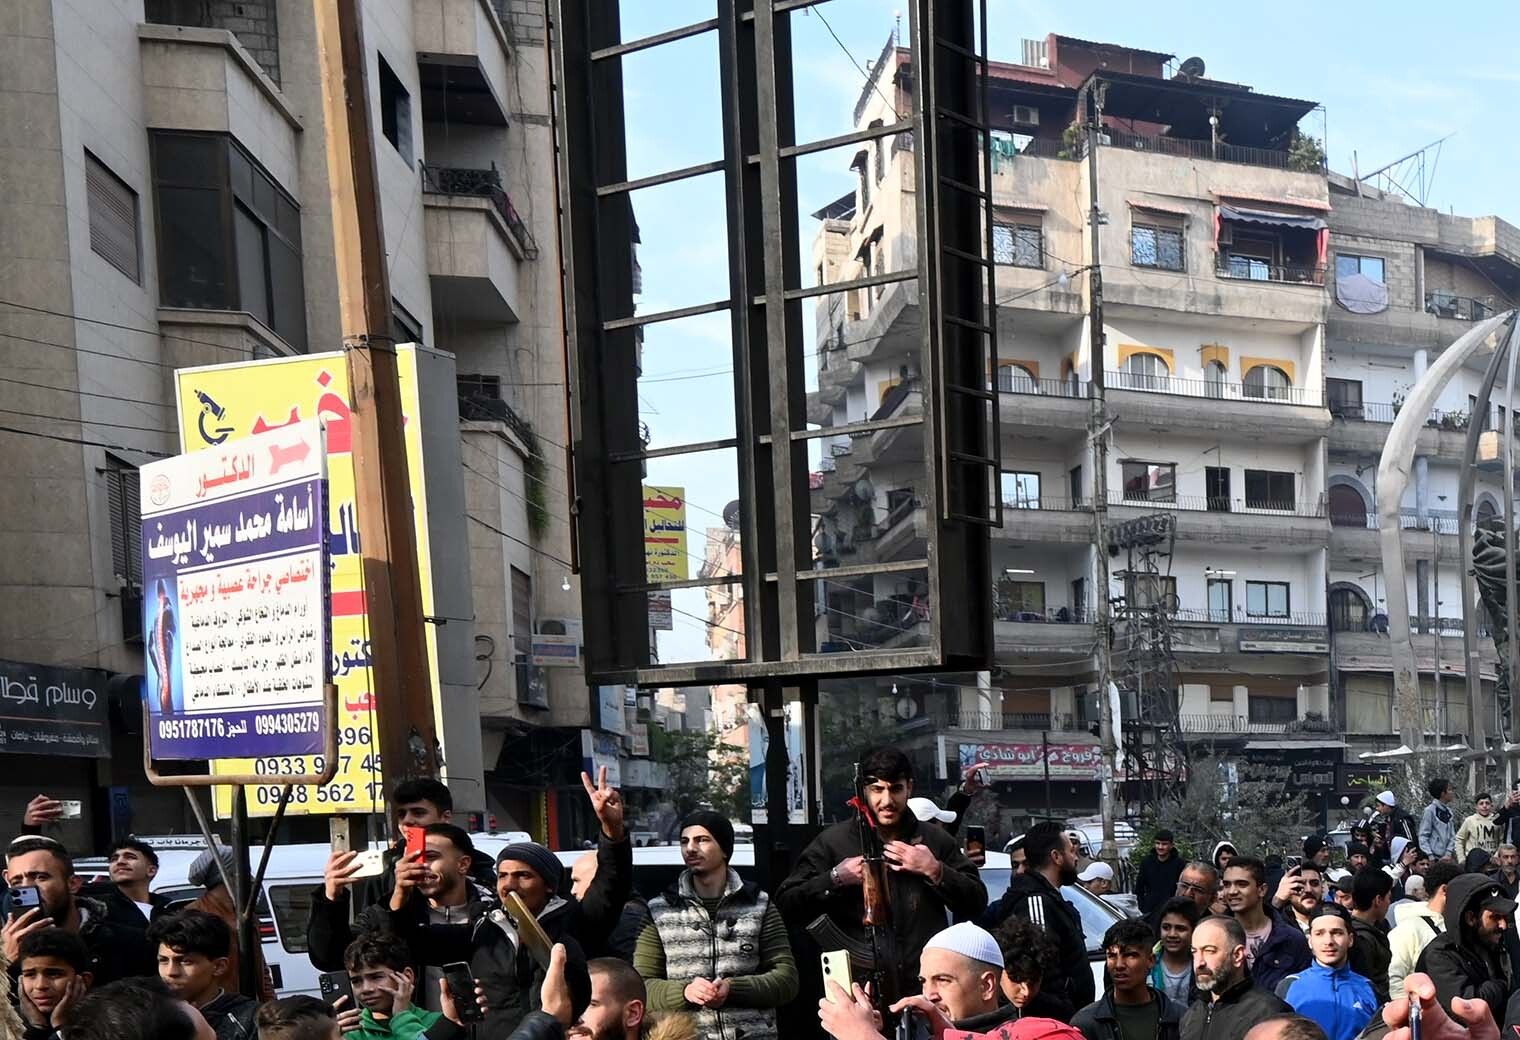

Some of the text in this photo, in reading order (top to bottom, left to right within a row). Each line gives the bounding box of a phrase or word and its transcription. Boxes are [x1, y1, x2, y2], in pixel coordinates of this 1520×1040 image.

[196, 453, 255, 498] الدكتور
[148, 484, 314, 566] أسامة محمد سمير اليوسف
[45, 682, 97, 710] وسام
[158, 711, 320, 739] 0994305279 للحجز 0951787176
[254, 757, 306, 777] 0933
[314, 755, 352, 776] 97
[316, 784, 356, 803] 562
